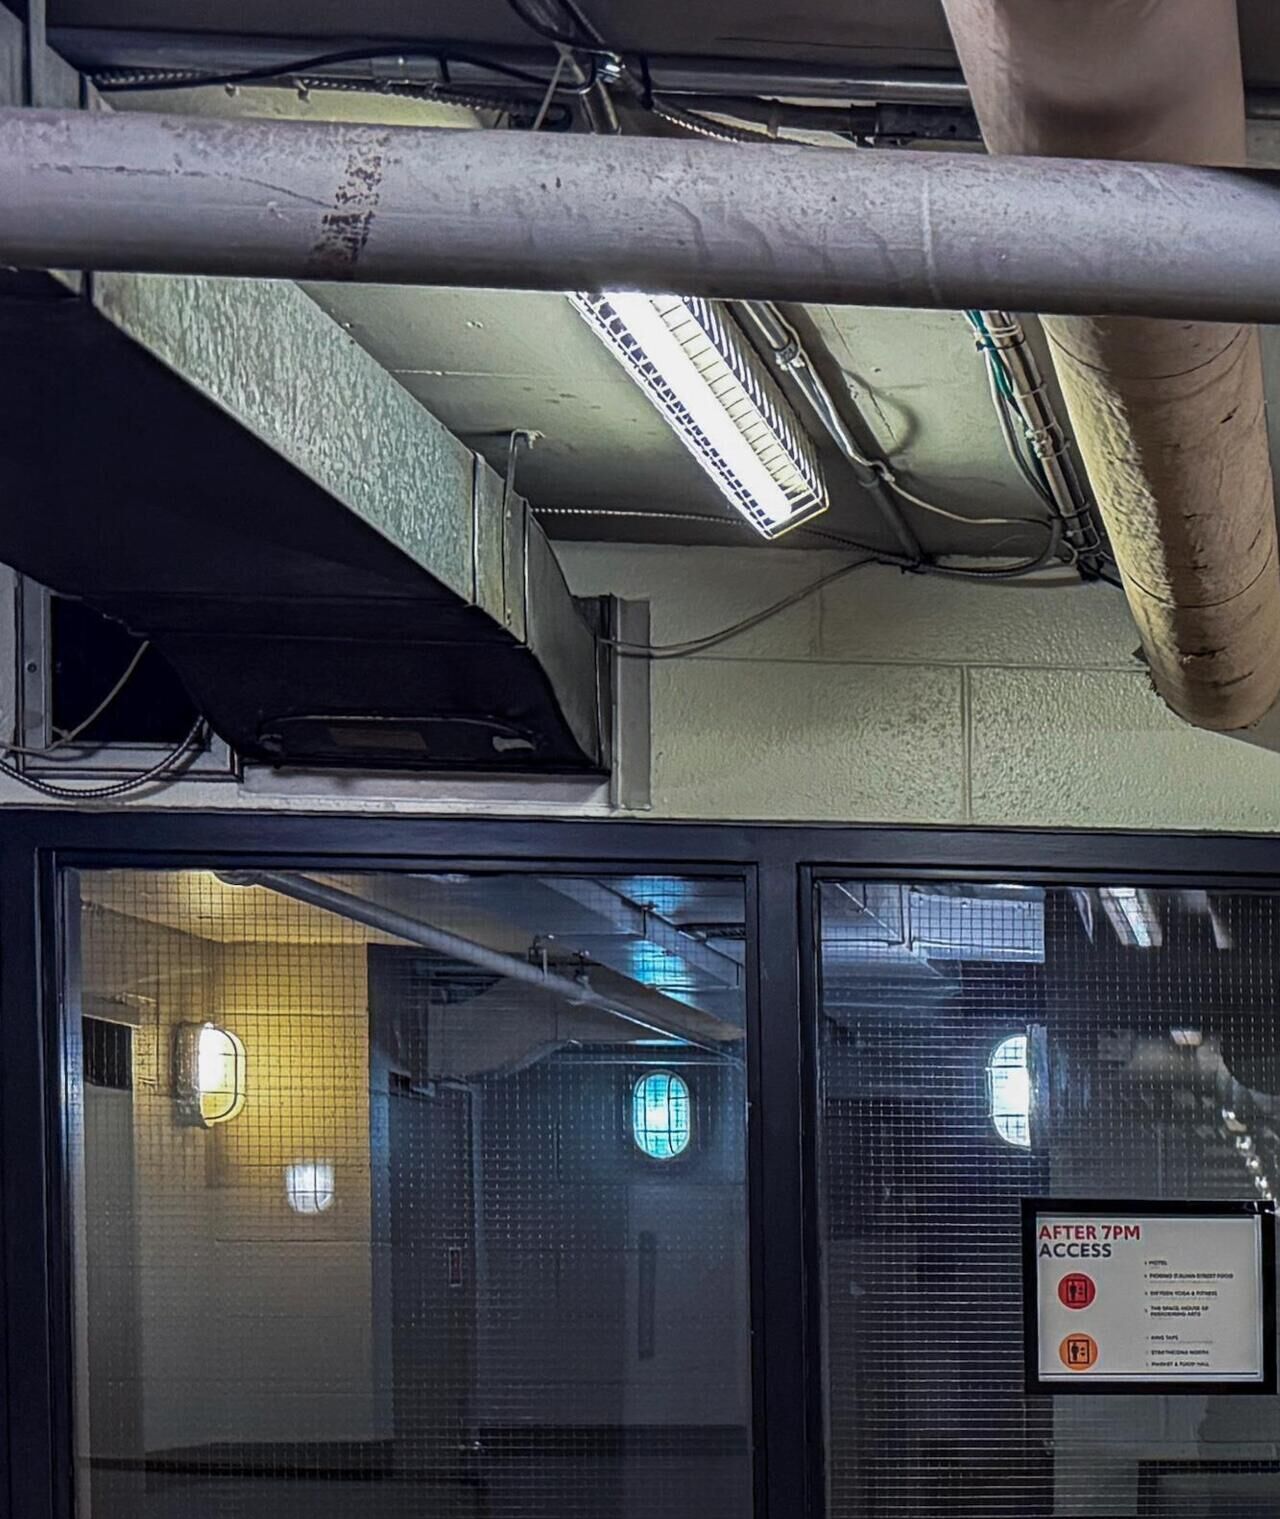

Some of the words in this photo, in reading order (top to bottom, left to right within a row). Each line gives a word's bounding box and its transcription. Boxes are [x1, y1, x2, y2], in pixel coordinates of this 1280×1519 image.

[1039, 1225, 1097, 1240] AFTER
[1101, 1225, 1140, 1240] 7PM
[1039, 1243, 1111, 1258] ACCESS
